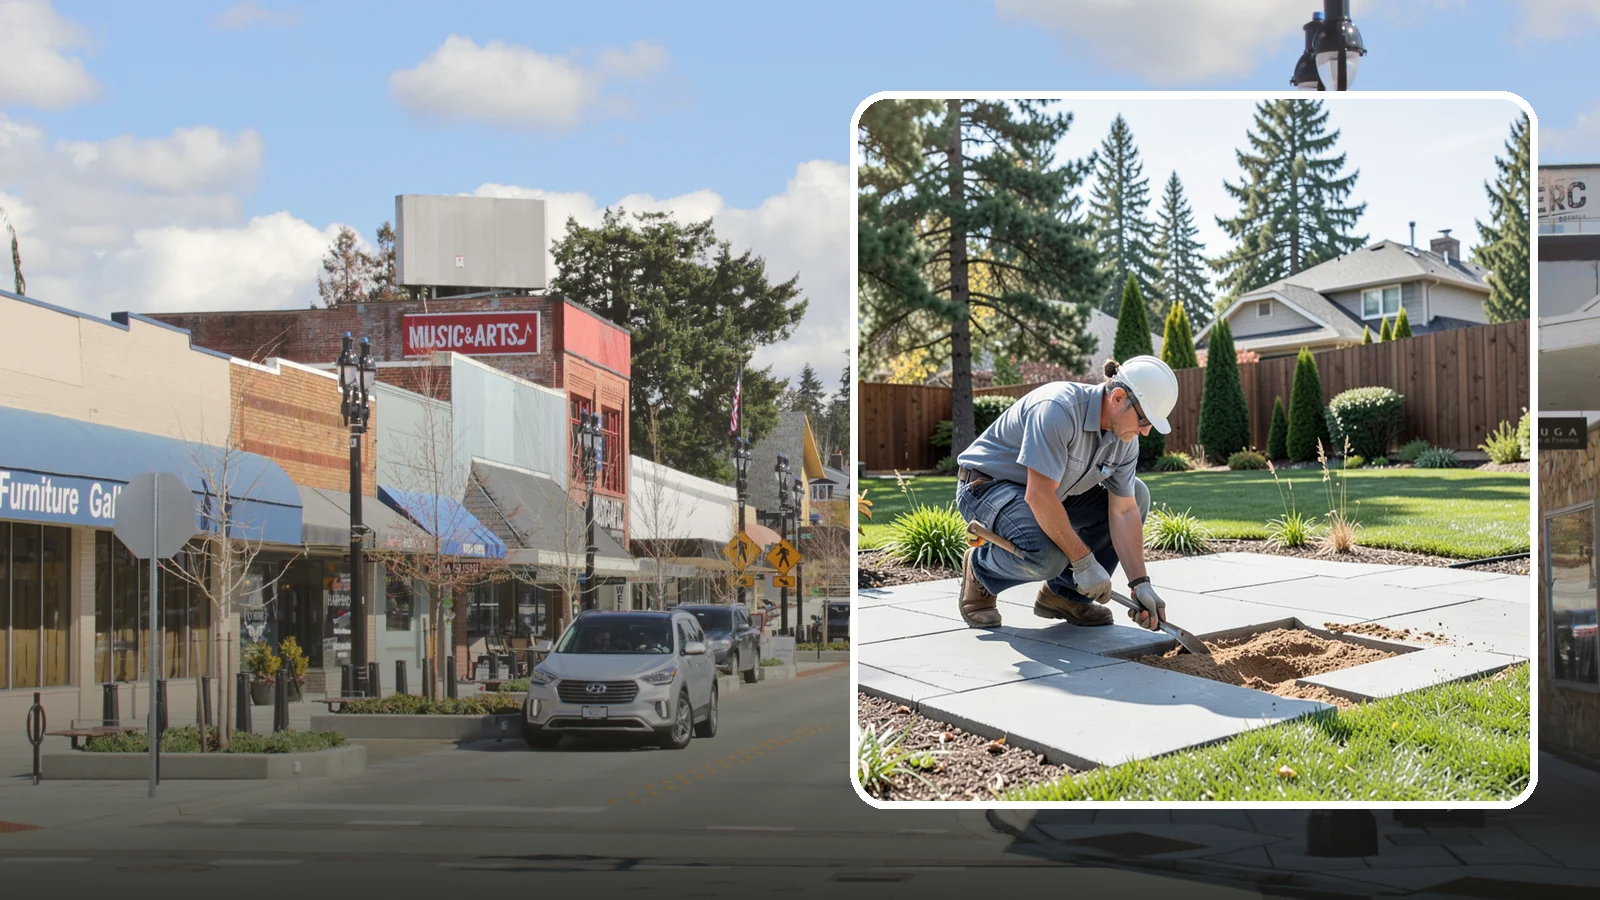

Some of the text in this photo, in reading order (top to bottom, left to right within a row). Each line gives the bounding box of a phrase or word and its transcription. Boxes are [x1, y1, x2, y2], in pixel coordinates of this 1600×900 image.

[1540, 427, 1577, 437] UGA
[0, 472, 122, 519] Furniture Gal
[453, 563, 480, 574] SUSHI
